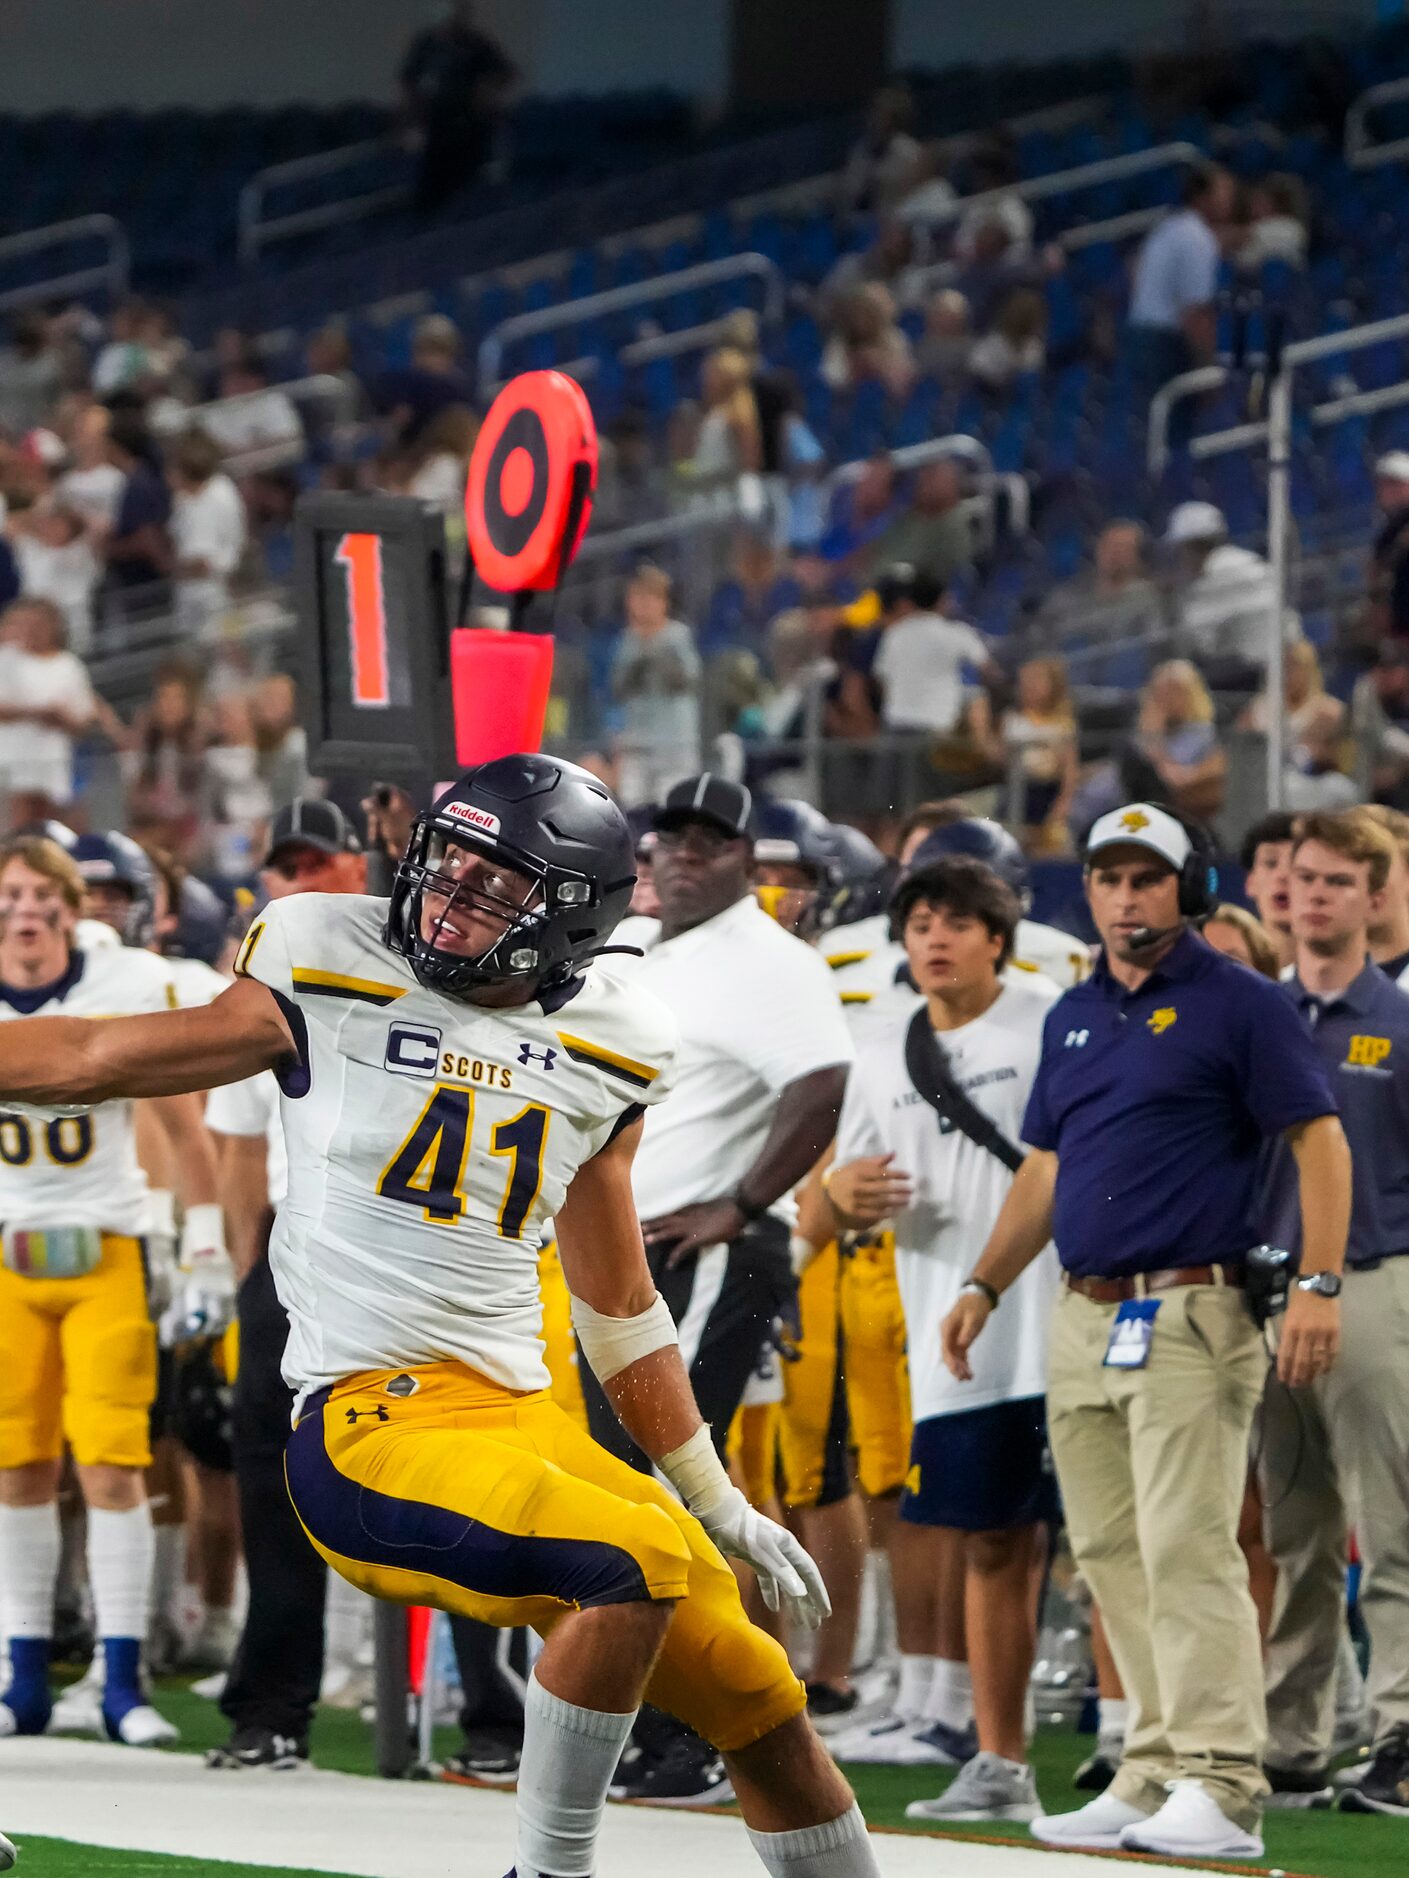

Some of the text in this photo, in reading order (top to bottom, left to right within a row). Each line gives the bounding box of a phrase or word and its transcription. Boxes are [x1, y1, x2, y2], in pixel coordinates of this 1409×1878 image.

[334, 533, 389, 706] 1
[449, 804, 494, 828] Riddell
[387, 1029, 439, 1070] C
[1347, 1035, 1392, 1065] HP
[441, 1052, 513, 1089] SCOTS
[375, 1082, 551, 1239] 41
